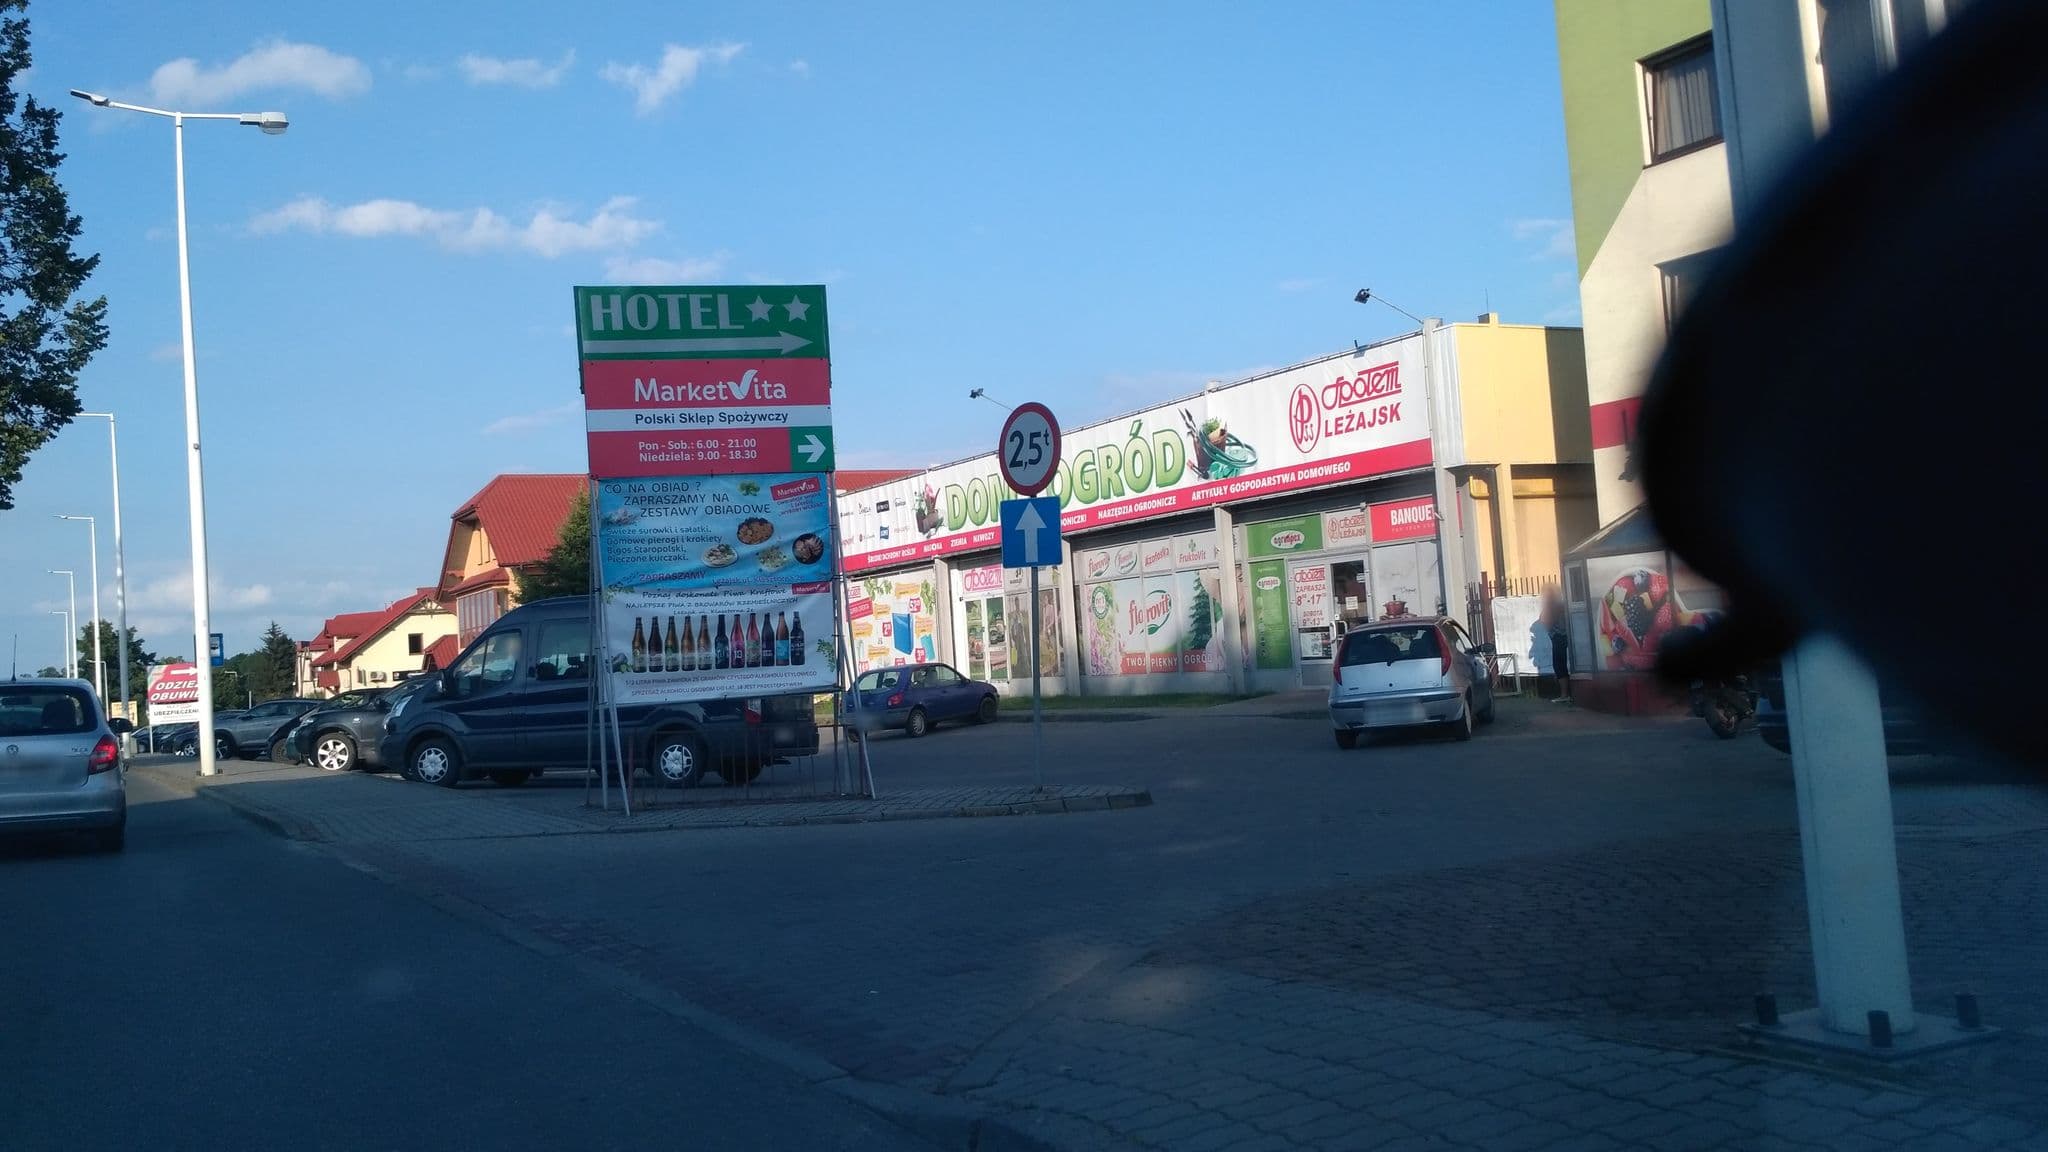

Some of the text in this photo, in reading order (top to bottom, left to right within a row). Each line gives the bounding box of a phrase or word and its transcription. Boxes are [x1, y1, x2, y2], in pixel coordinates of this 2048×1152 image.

[590, 293, 744, 331] HOTEL
[634, 369, 787, 402] MarketVita
[635, 411, 788, 425] Polski Sklep Spożywczy
[1324, 402, 1402, 438] LEŻAJSK
[638, 441, 659, 451] Pon
[696, 439, 719, 450] 6.00
[727, 438, 756, 449] 21.00
[639, 452, 695, 462] Niedziela:
[697, 451, 720, 461] 9.00
[728, 450, 757, 460] 18.30
[945, 419, 1186, 531] DOM OGRÓD
[604, 481, 701, 494] CO NA OBIAD ?
[624, 493, 730, 506] ZAPRASZAMY NA
[1098, 505, 1134, 520] NARZĘDZIA
[1133, 495, 1176, 512] OGRODNICZE
[1191, 486, 1228, 501] ARTYKUŁY
[1229, 473, 1297, 494] GOSPODARSTWA
[1297, 461, 1351, 480] DOMOWEGO
[640, 506, 699, 518] ZESTAWY
[704, 503, 771, 516] OBIADOWE
[1128, 593, 1170, 635] florovit
